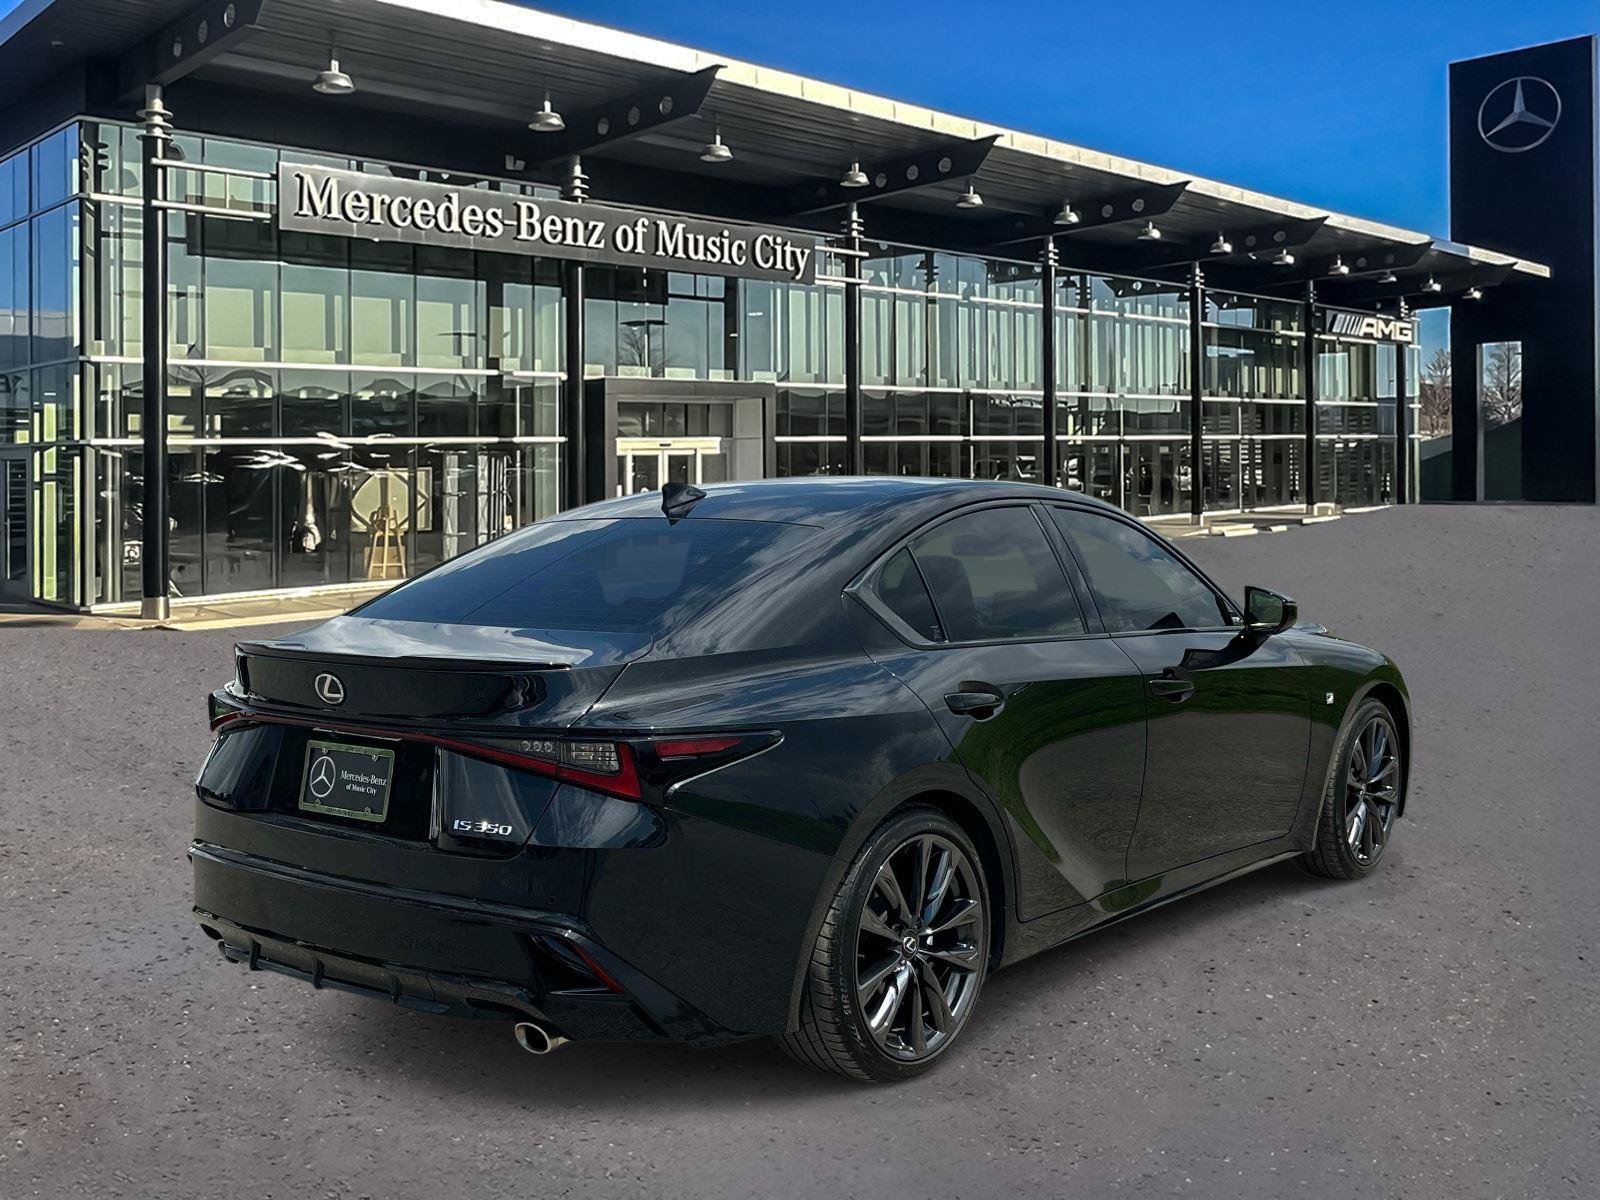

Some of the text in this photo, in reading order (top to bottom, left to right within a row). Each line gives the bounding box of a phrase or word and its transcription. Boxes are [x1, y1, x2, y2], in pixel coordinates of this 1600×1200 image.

[295, 171, 811, 280] Mercedes-Benz of Music City
[1359, 317, 1413, 342] AMG
[340, 769, 387, 786] Mercedes-Benz
[352, 783, 367, 793] Music
[366, 786, 377, 796] City
[453, 819, 513, 836] IS 350
